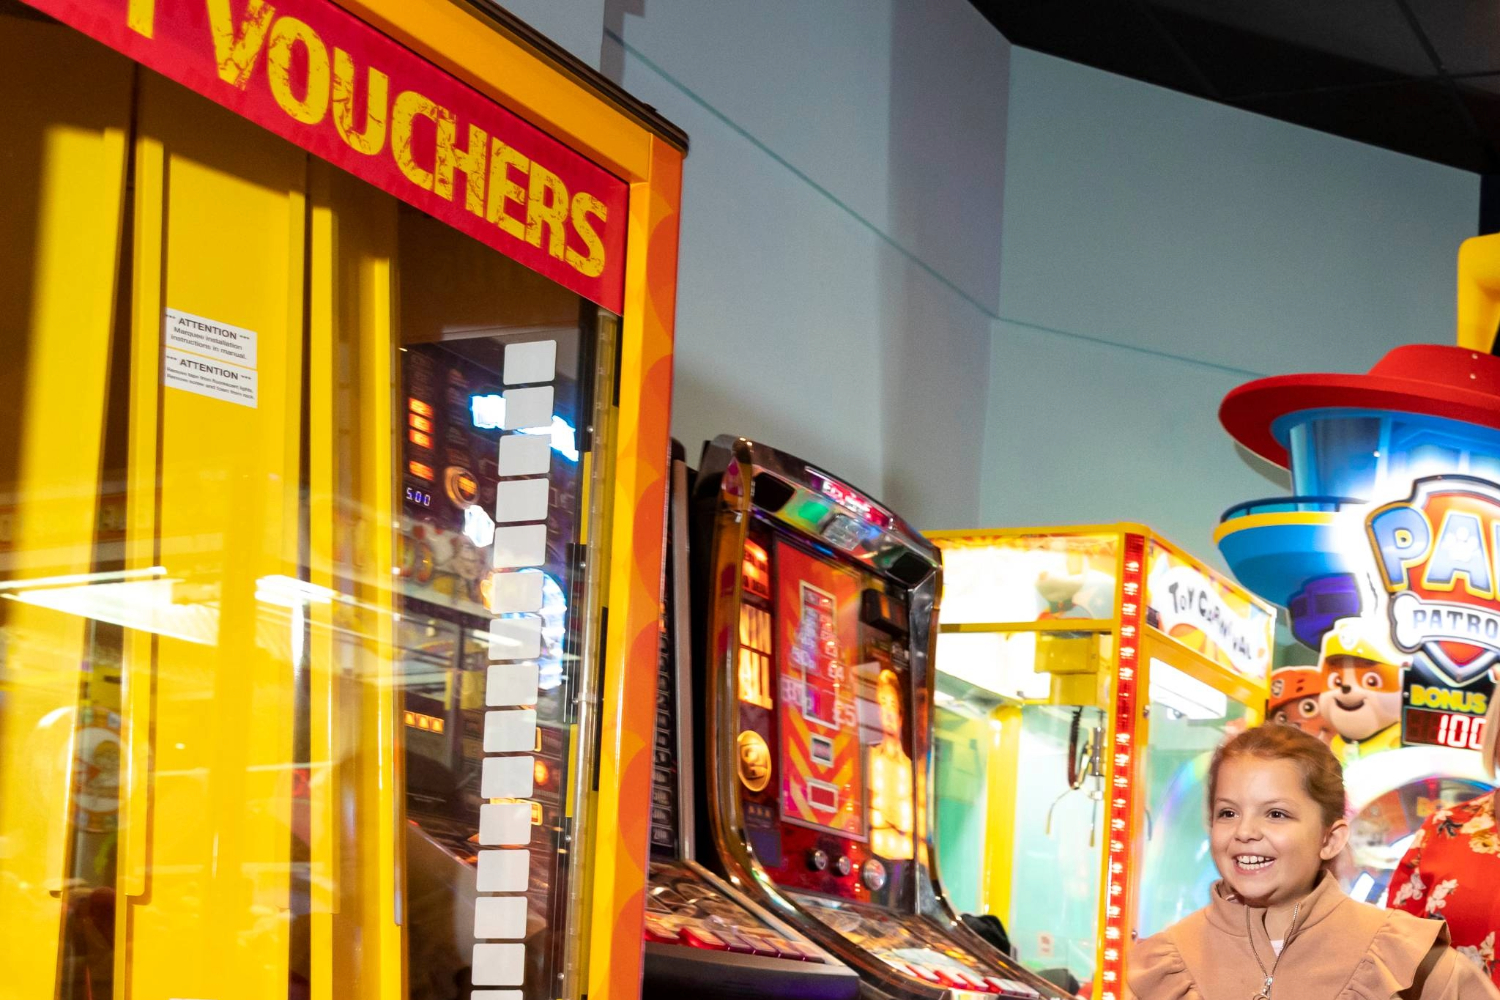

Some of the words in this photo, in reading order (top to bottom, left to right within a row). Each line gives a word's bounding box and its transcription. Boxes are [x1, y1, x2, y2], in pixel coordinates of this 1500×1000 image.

[206, 0, 608, 278] VOUCHERS
[178, 317, 238, 340] ATTENTION
[179, 358, 239, 381] ATTENTION
[1409, 684, 1488, 714] BONUS
